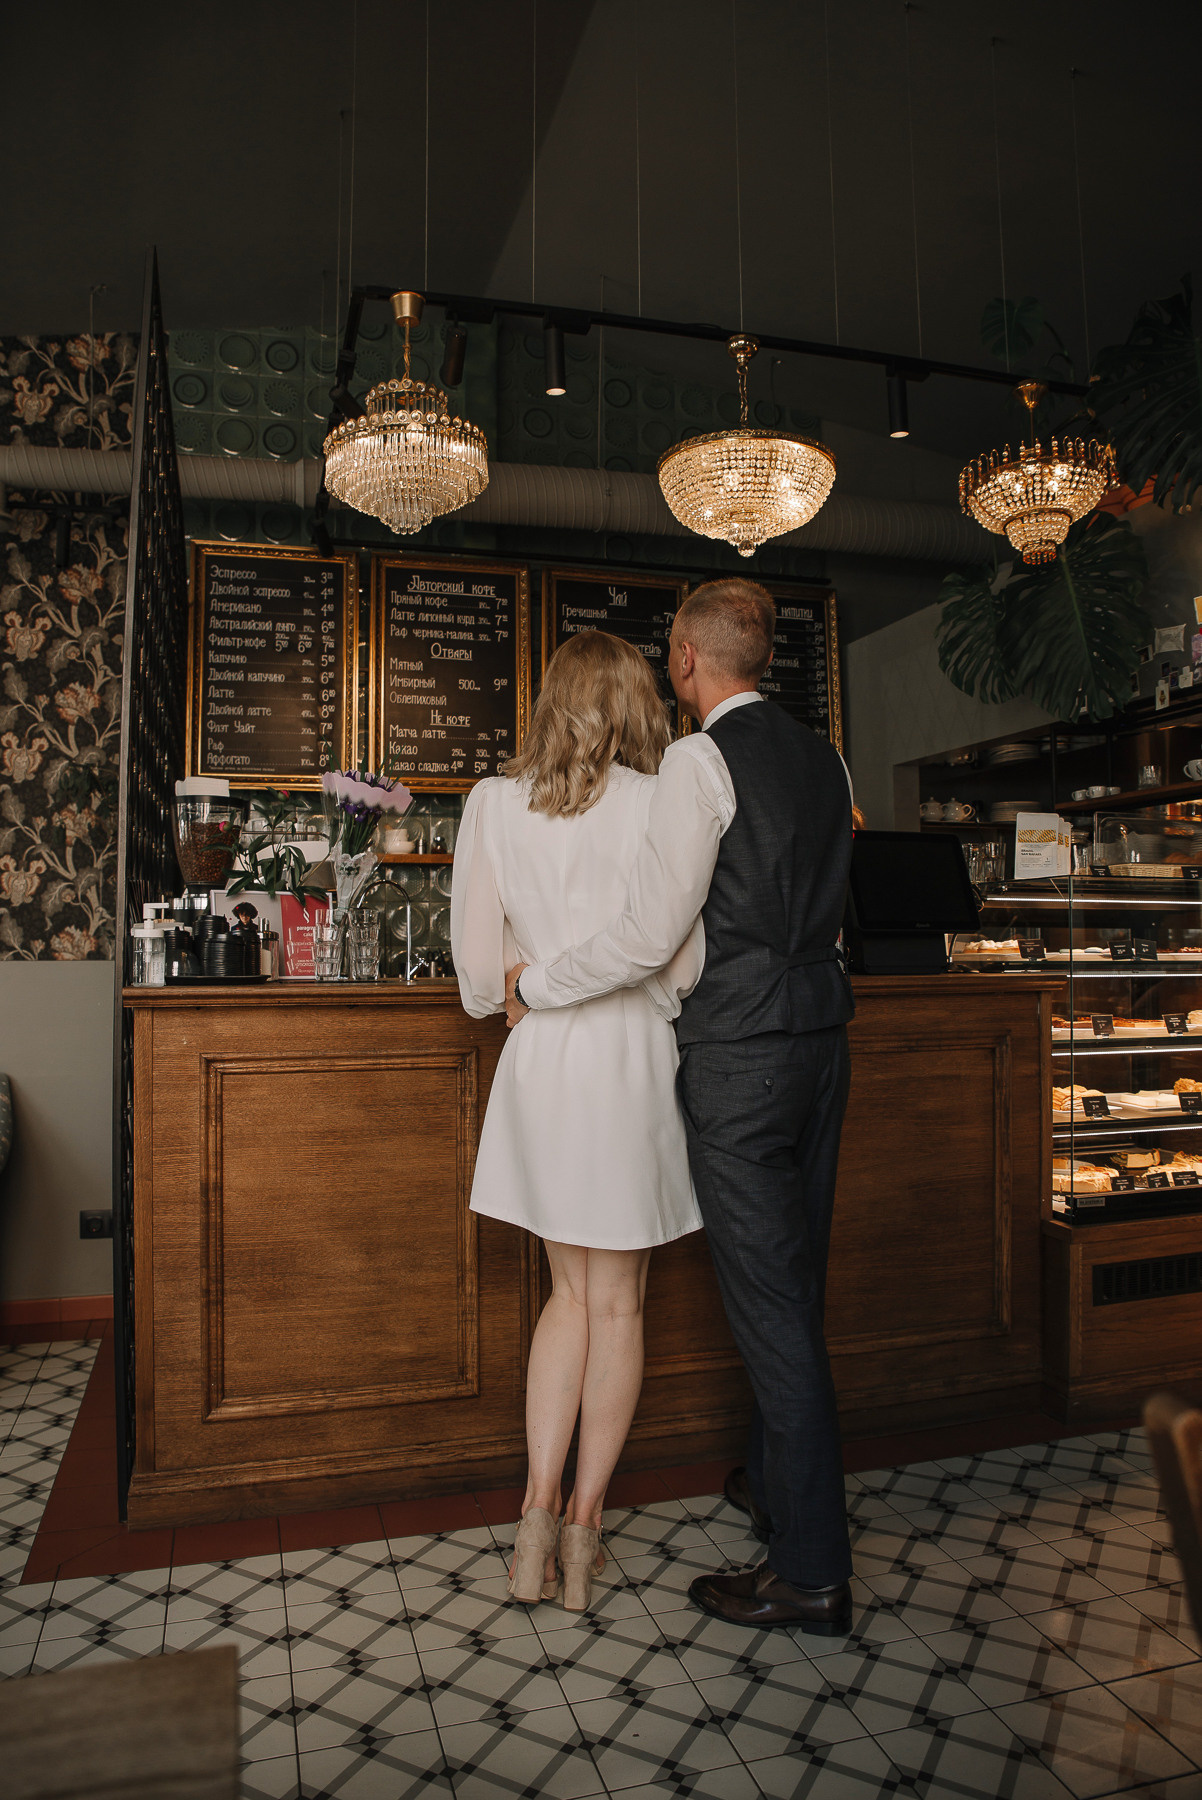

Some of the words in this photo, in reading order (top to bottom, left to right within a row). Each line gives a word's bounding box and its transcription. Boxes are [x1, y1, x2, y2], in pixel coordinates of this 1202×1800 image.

[210, 564, 257, 581] Эспрессо
[210, 581, 249, 595] Двойной
[253, 587, 291, 600] эспрессо
[210, 598, 262, 615] Американо
[391, 591, 422, 605] Пряный
[425, 596, 448, 608] кофе
[391, 607, 415, 621] Латте
[418, 612, 454, 623] лимонный
[457, 615, 475, 626] курд
[562, 604, 608, 619] Гречишный
[209, 615, 273, 631] Австралийский
[391, 623, 408, 639] Раф
[208, 633, 267, 649] Фильтр-кофе
[208, 650, 247, 664] Капучино
[390, 657, 424, 671] Мятный
[208, 667, 244, 682] Двойной
[247, 672, 285, 683] капучино
[390, 674, 436, 690] Имбирный
[208, 685, 235, 698] Латте
[390, 691, 447, 706] Облепиховый
[207, 702, 244, 716] Двойной
[247, 707, 272, 717] латте
[207, 719, 229, 733] Флэт
[234, 720, 256, 733] Уайт
[390, 724, 418, 738] Матча
[421, 729, 446, 739] латте
[207, 737, 224, 753] Раф
[207, 752, 251, 767] Аффогато
[418, 762, 450, 773] сладкое
